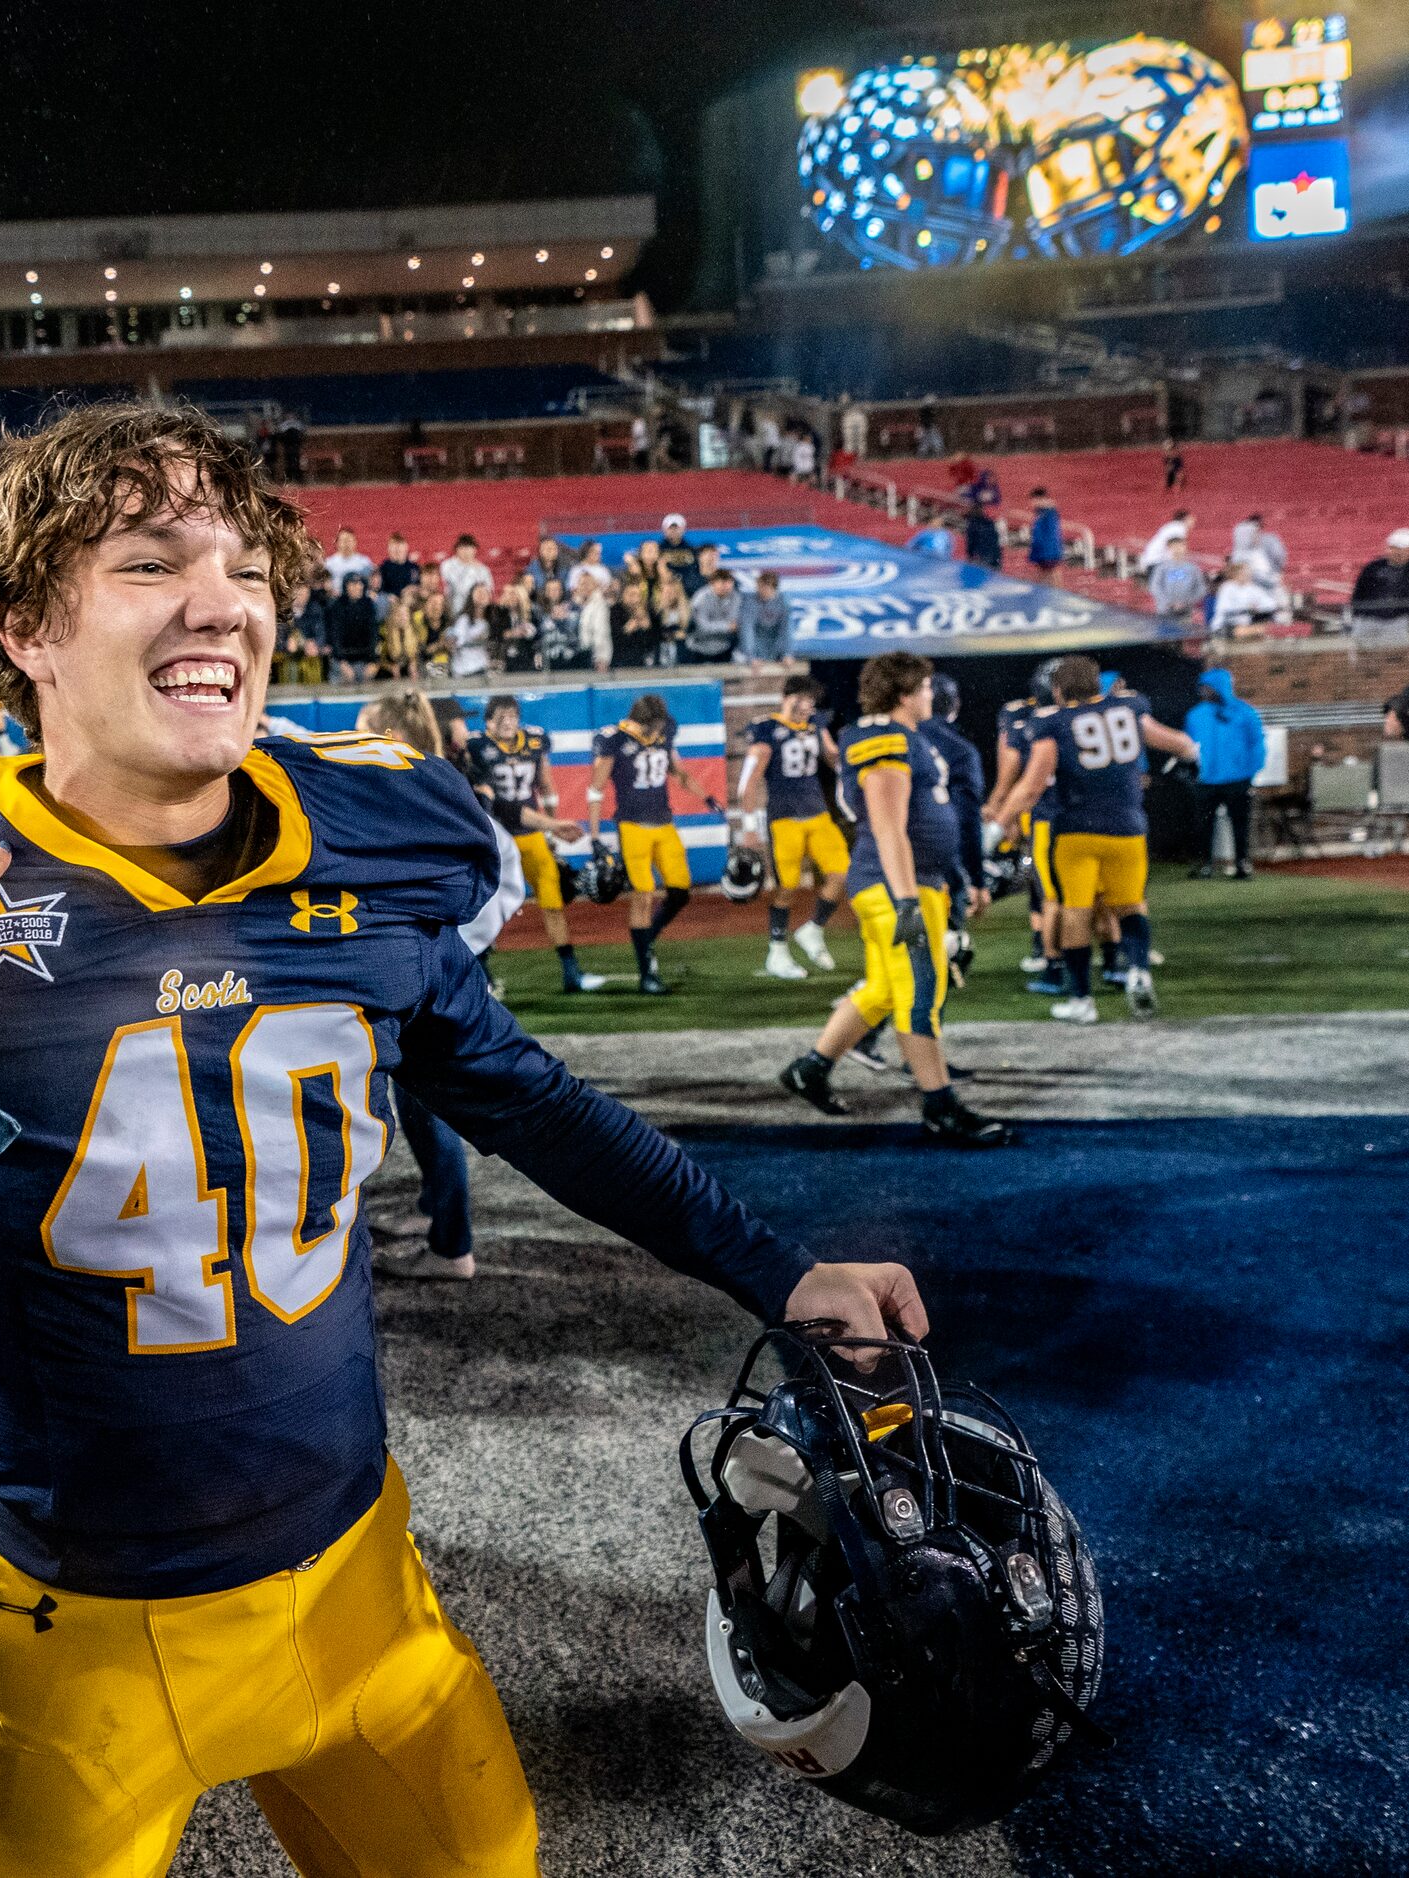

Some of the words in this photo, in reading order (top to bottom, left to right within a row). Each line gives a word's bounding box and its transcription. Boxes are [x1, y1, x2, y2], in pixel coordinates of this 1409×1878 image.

[792, 600, 1092, 641] Dallas
[1071, 706, 1139, 770] 98
[493, 761, 536, 801] 37
[21, 917, 51, 928] 2005
[23, 929, 52, 940] 2018
[155, 968, 253, 1014] Scots
[39, 1002, 388, 1356] 40
[1060, 1591, 1079, 1628] PRIDE
[1060, 1638, 1079, 1674] PRIDE
[1080, 1637, 1096, 1673] PRIDE
